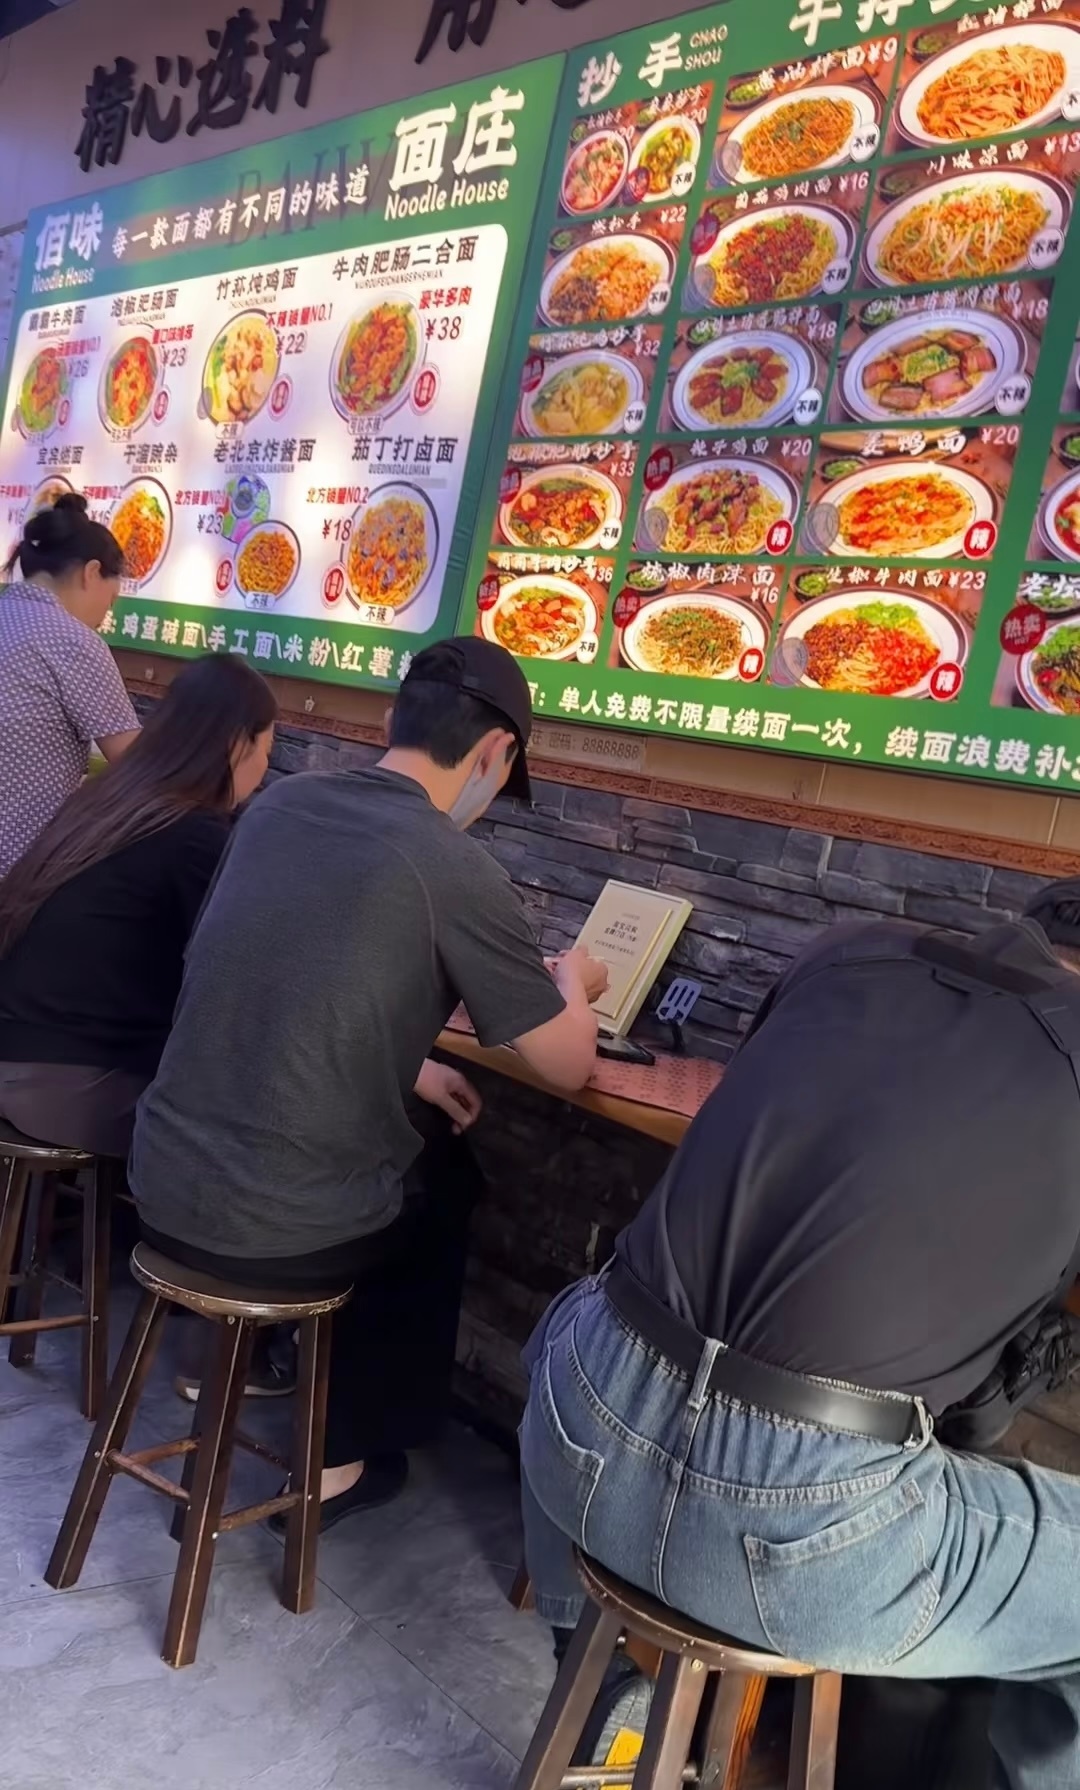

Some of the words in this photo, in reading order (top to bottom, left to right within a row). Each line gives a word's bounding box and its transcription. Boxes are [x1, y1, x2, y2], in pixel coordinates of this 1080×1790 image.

[689, 25, 728, 49] CHAO
[684, 48, 722, 72] SHOU
[867, 36, 898, 65] ¥9
[577, 32, 683, 108] 抄手
[387, 86, 525, 193] 面庄
[838, 171, 869, 193] ¥16
[111, 165, 371, 259] 每一款面都有不同的味道
[385, 183, 447, 222] Noodle
[449, 178, 510, 209] House
[660, 205, 687, 223] ¥22
[34, 202, 103, 272] 佰味
[332, 235, 479, 282] 牛肉肥肠二合面
[216, 266, 298, 301] 竹荪炖鸡面
[418, 286, 473, 310] 豪华多肉
[266, 302, 334, 328] 不辣销量NO.1
[425, 315, 462, 343] ¥38
[808, 321, 838, 340] ¥18
[276, 332, 306, 356] ¥22
[634, 340, 661, 356] ¥32
[161, 346, 187, 367] ¥23
[982, 425, 1019, 445] ¥20
[214, 438, 316, 464] 老北京炸酱面
[352, 435, 458, 464] 茄丁打卤面
[782, 438, 812, 457] ¥20
[610, 461, 635, 476] ¥33
[197, 514, 223, 535] ¥23
[322, 518, 352, 542] ¥18
[602, 526, 620, 538] 不辣
[948, 570, 986, 591] ¥23
[750, 586, 778, 603] ¥16
[365, 605, 387, 622] 不辣
[578, 640, 596, 653] 不辣
